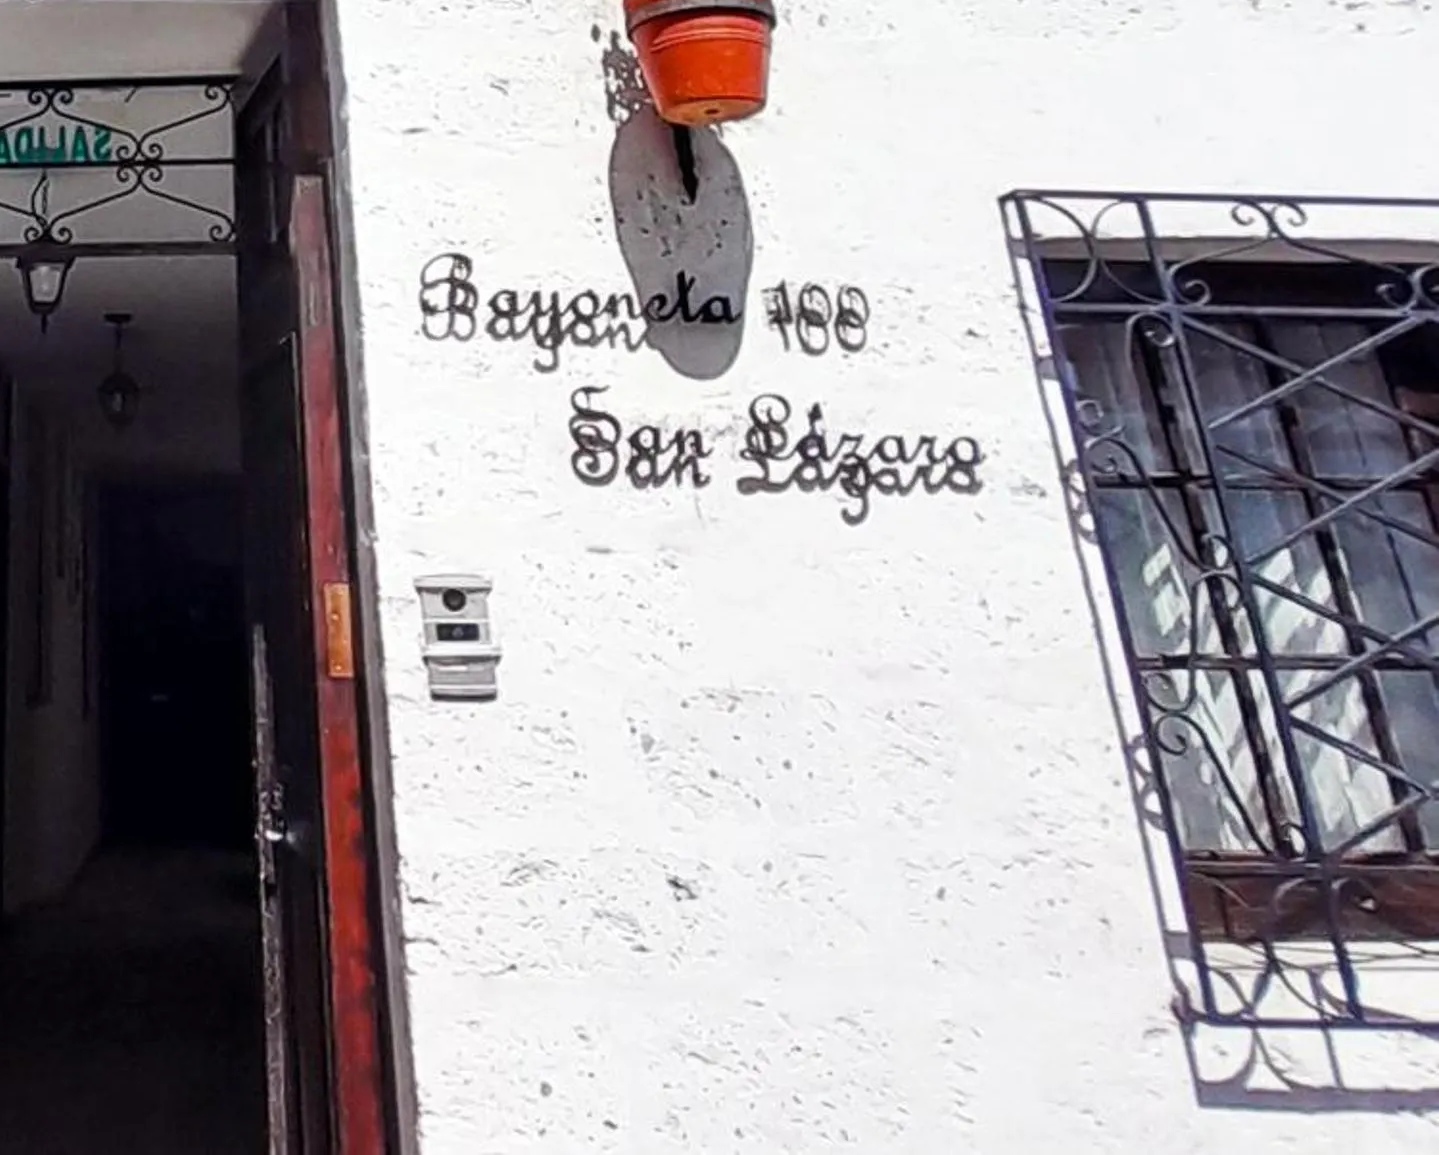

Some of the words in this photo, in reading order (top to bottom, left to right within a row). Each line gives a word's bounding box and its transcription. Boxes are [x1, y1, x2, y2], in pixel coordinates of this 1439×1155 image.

[419, 252, 743, 352] Bayoneta
[570, 386, 713, 460] San
[740, 393, 985, 499] Lázaro
